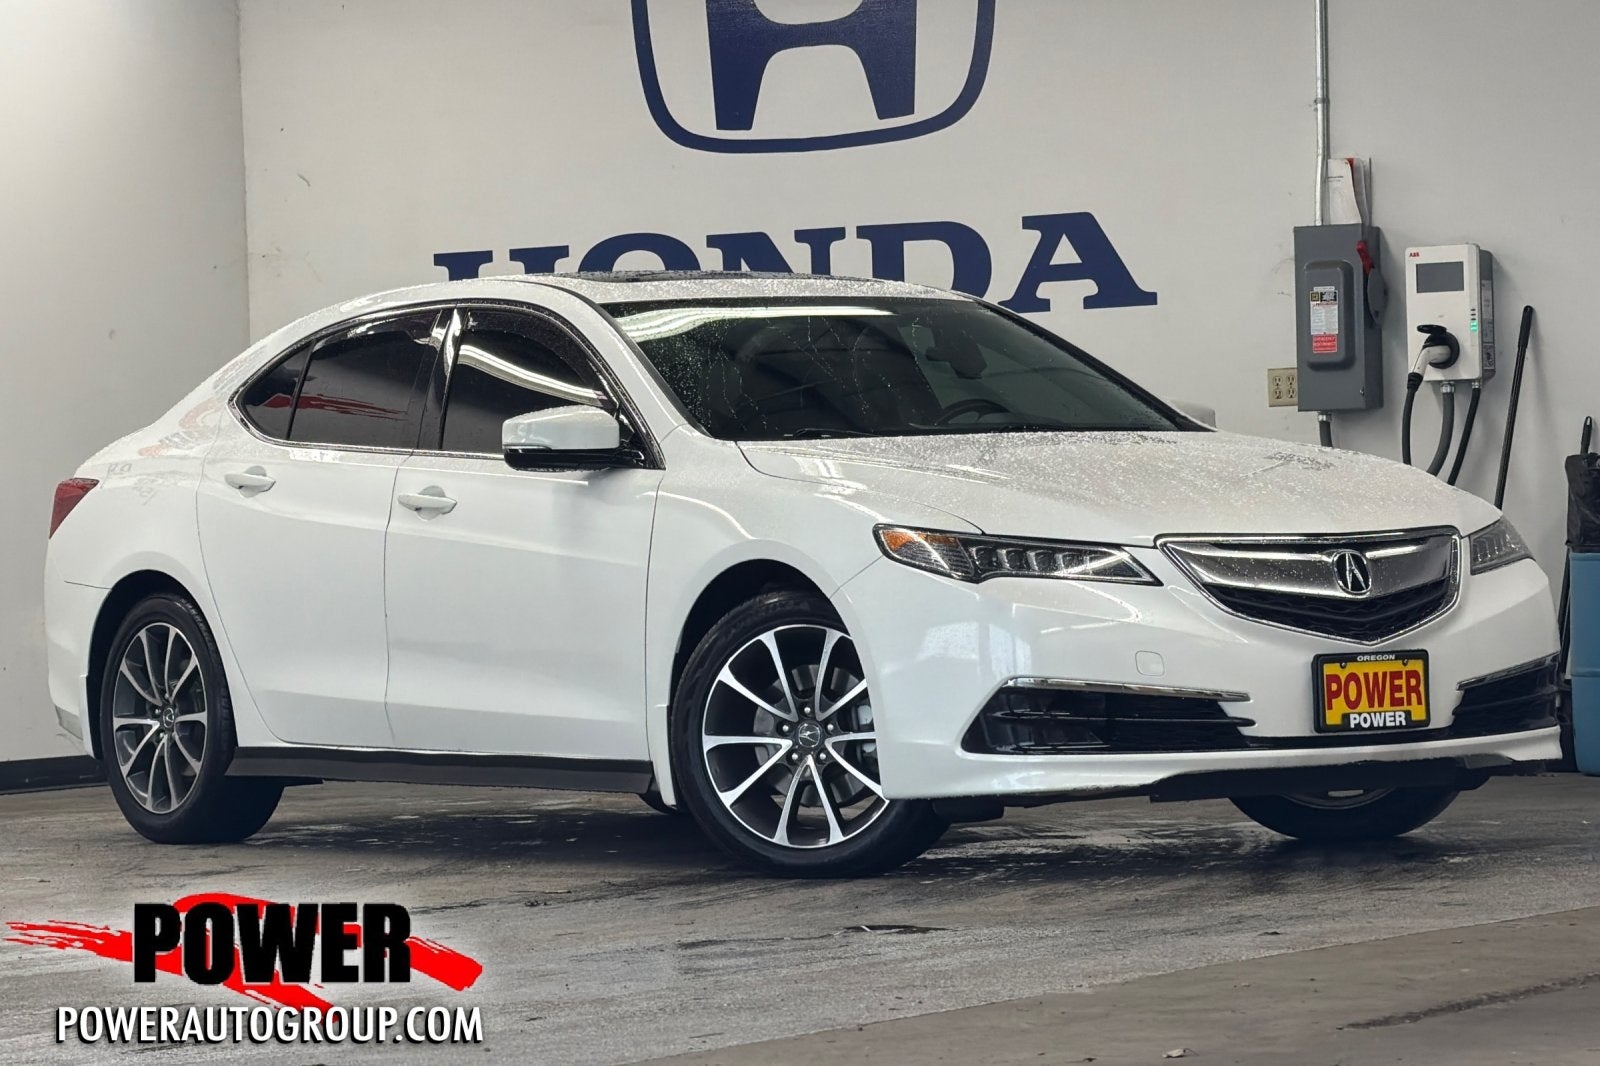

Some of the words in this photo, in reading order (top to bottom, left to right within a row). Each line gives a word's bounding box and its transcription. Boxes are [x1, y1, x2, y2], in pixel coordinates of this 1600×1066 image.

[433, 211, 1158, 314] NDA
[1356, 654, 1396, 662] OREGON
[1325, 669, 1424, 711] POWER
[1349, 711, 1407, 729] POWER
